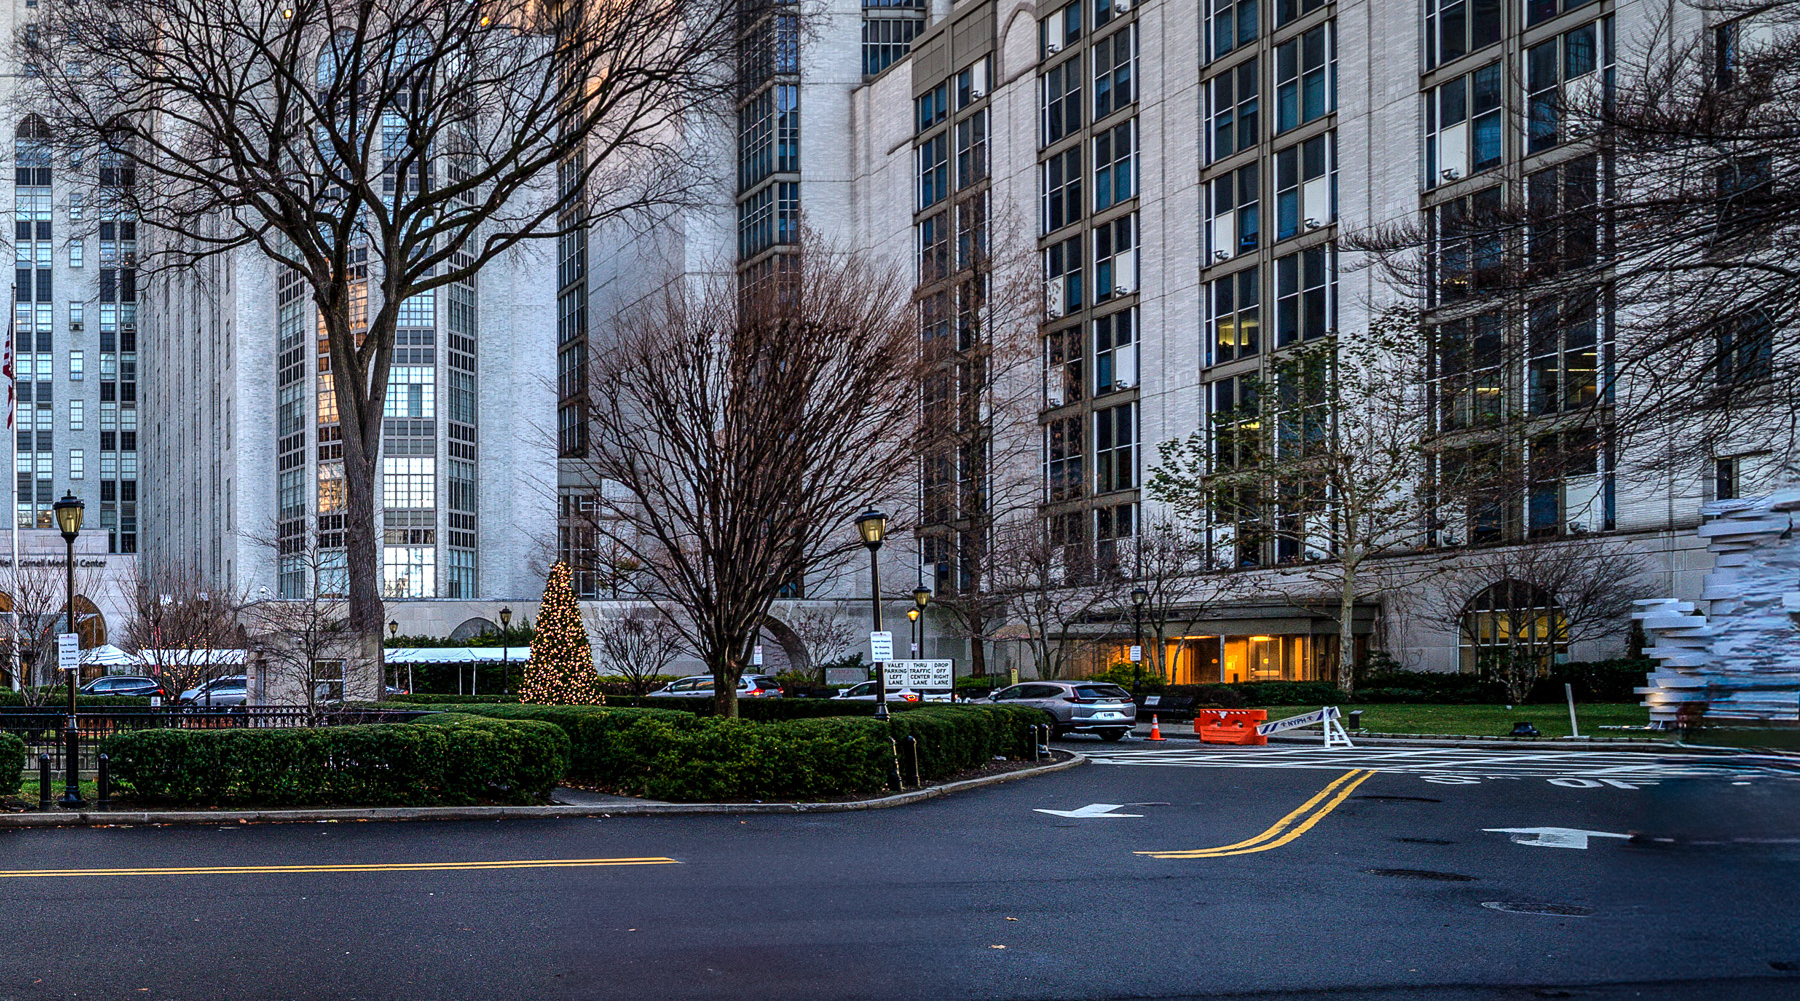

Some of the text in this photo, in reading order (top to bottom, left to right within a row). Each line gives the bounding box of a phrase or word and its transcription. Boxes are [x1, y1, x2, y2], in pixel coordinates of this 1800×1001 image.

[18, 559, 46, 568] Cornell
[48, 559, 78, 568] Medial
[80, 559, 106, 568] Center
[1287, 718, 1306, 726] NYPH
[1419, 775, 1661, 790] SOP
